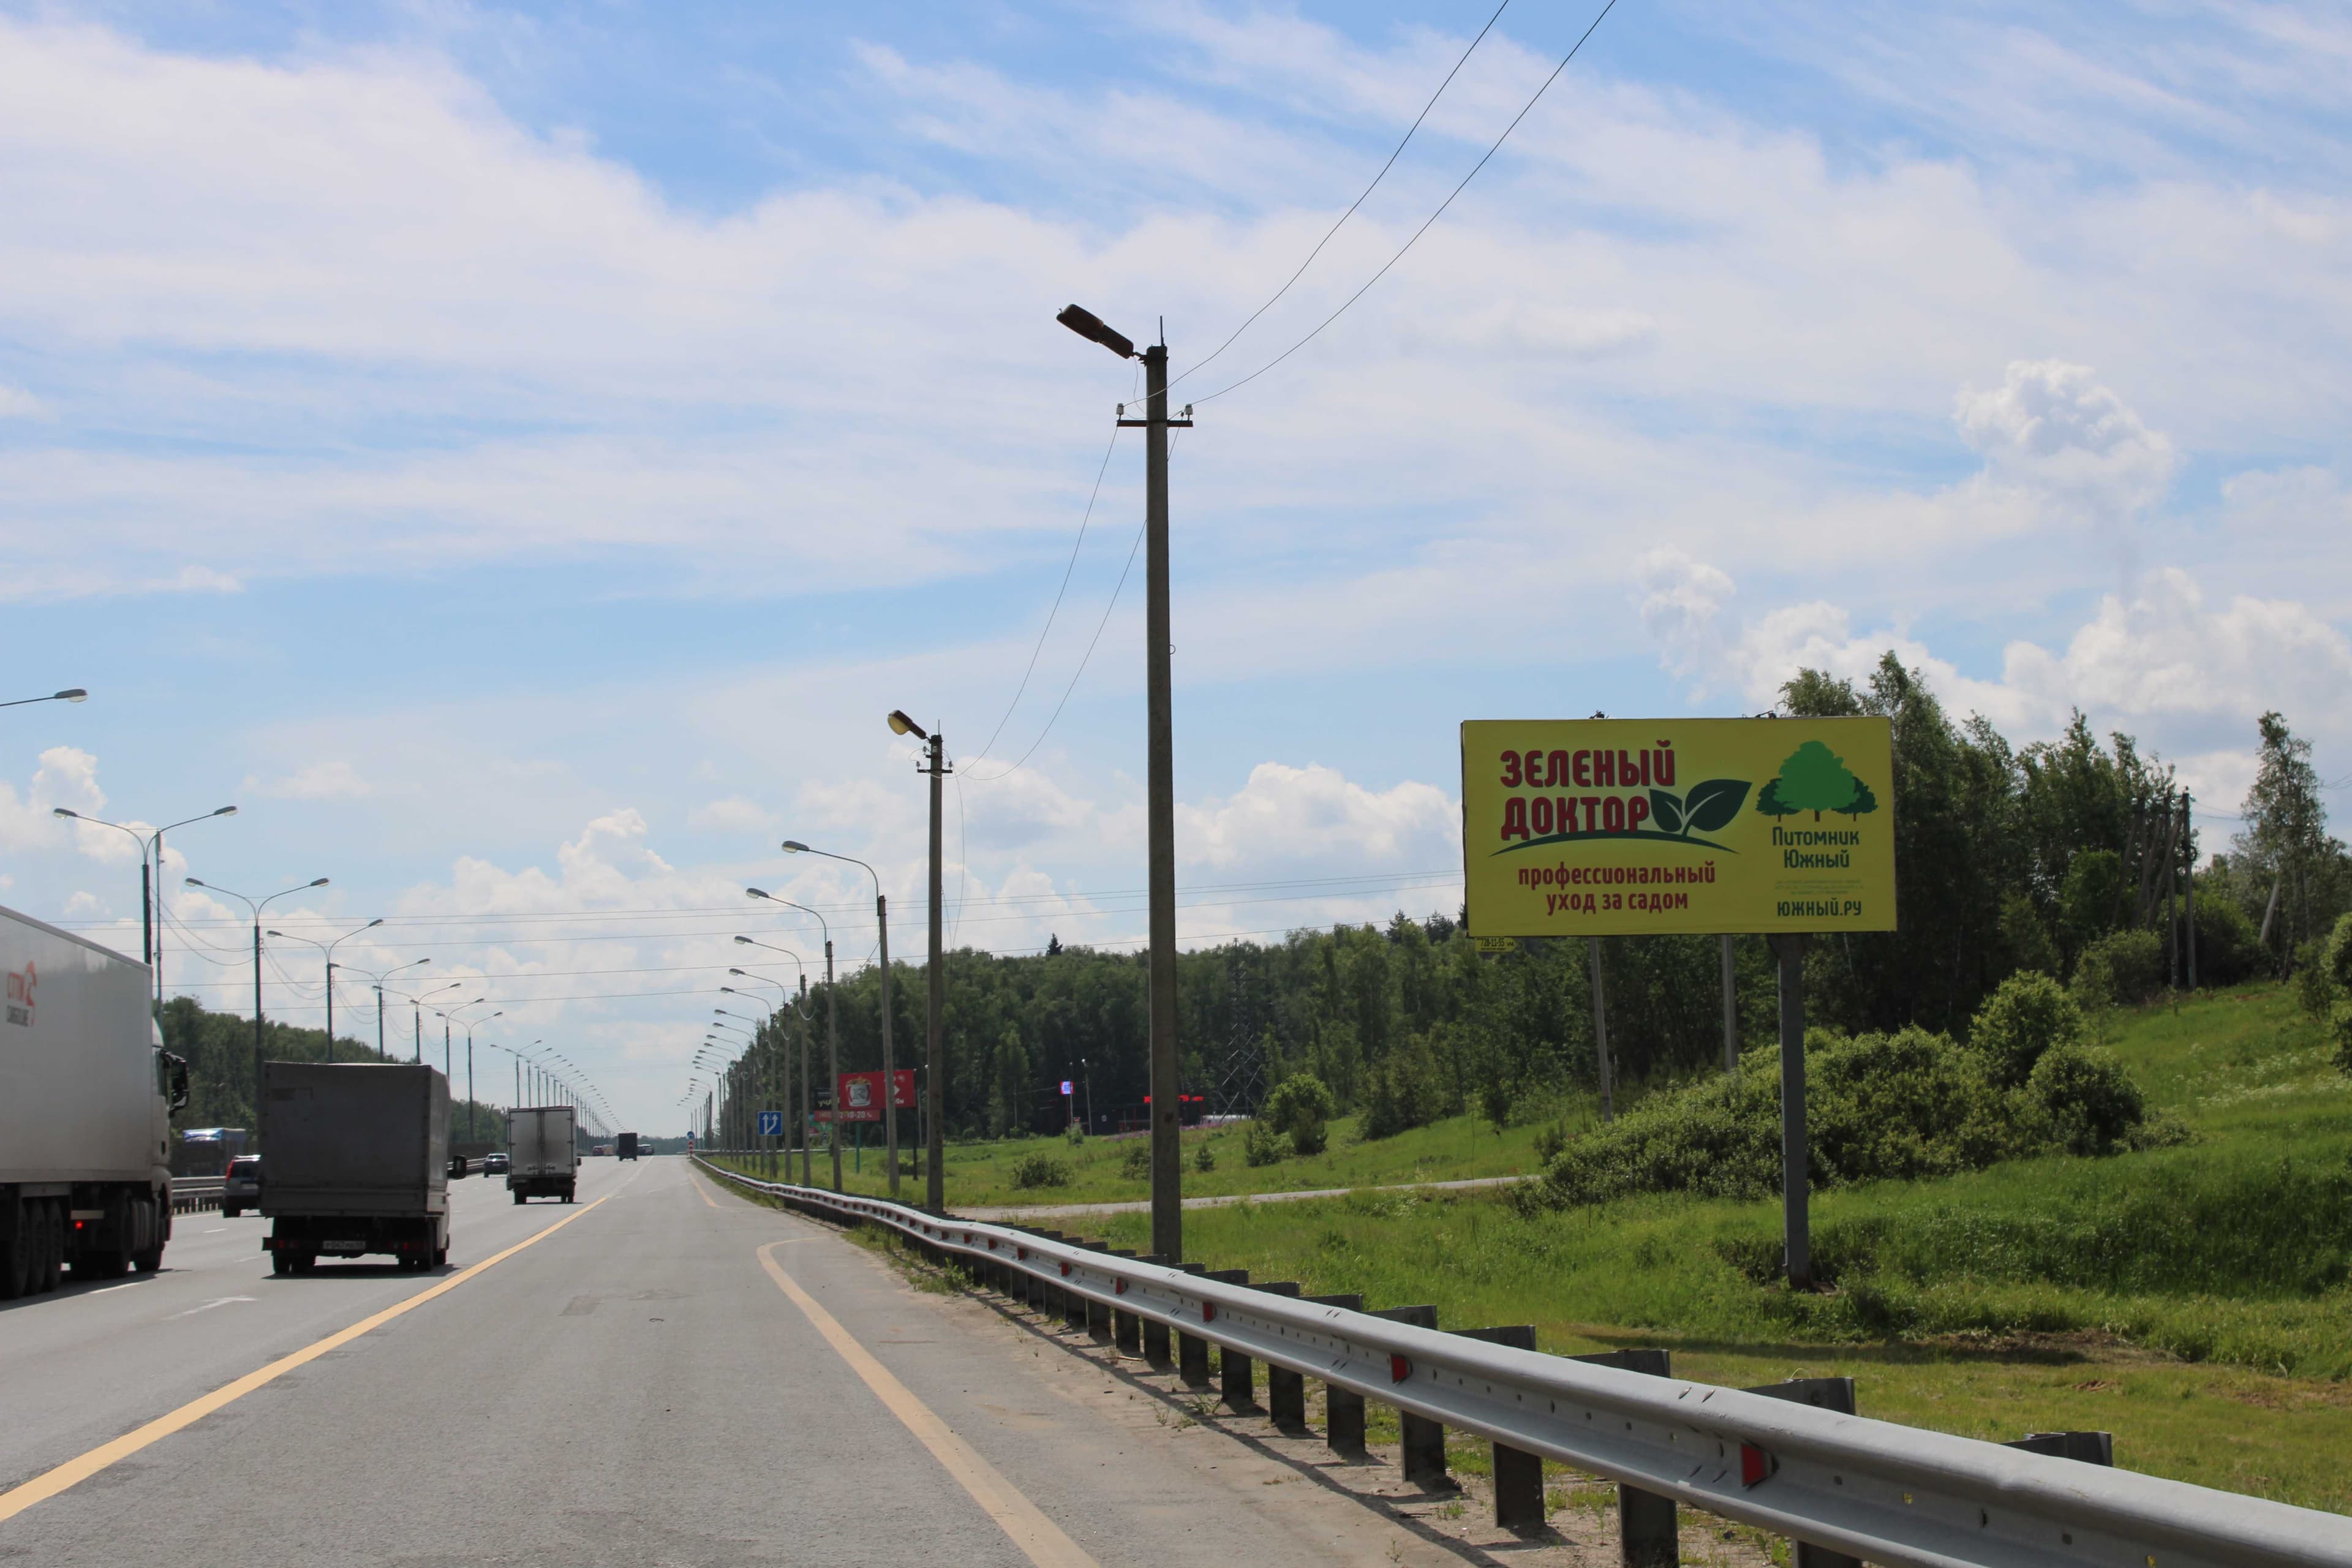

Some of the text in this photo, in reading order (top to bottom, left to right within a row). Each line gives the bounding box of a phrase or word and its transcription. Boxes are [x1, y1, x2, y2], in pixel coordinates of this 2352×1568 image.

[1501, 739, 1675, 788] ЗЕЛЕНЫЙ
[1501, 796, 1650, 841] ДОКТОР
[1773, 826, 1860, 846] Питомник
[1784, 849, 1850, 868] Южный
[1518, 861, 1716, 891] профессиональный
[1547, 892, 1689, 916] уход за садом
